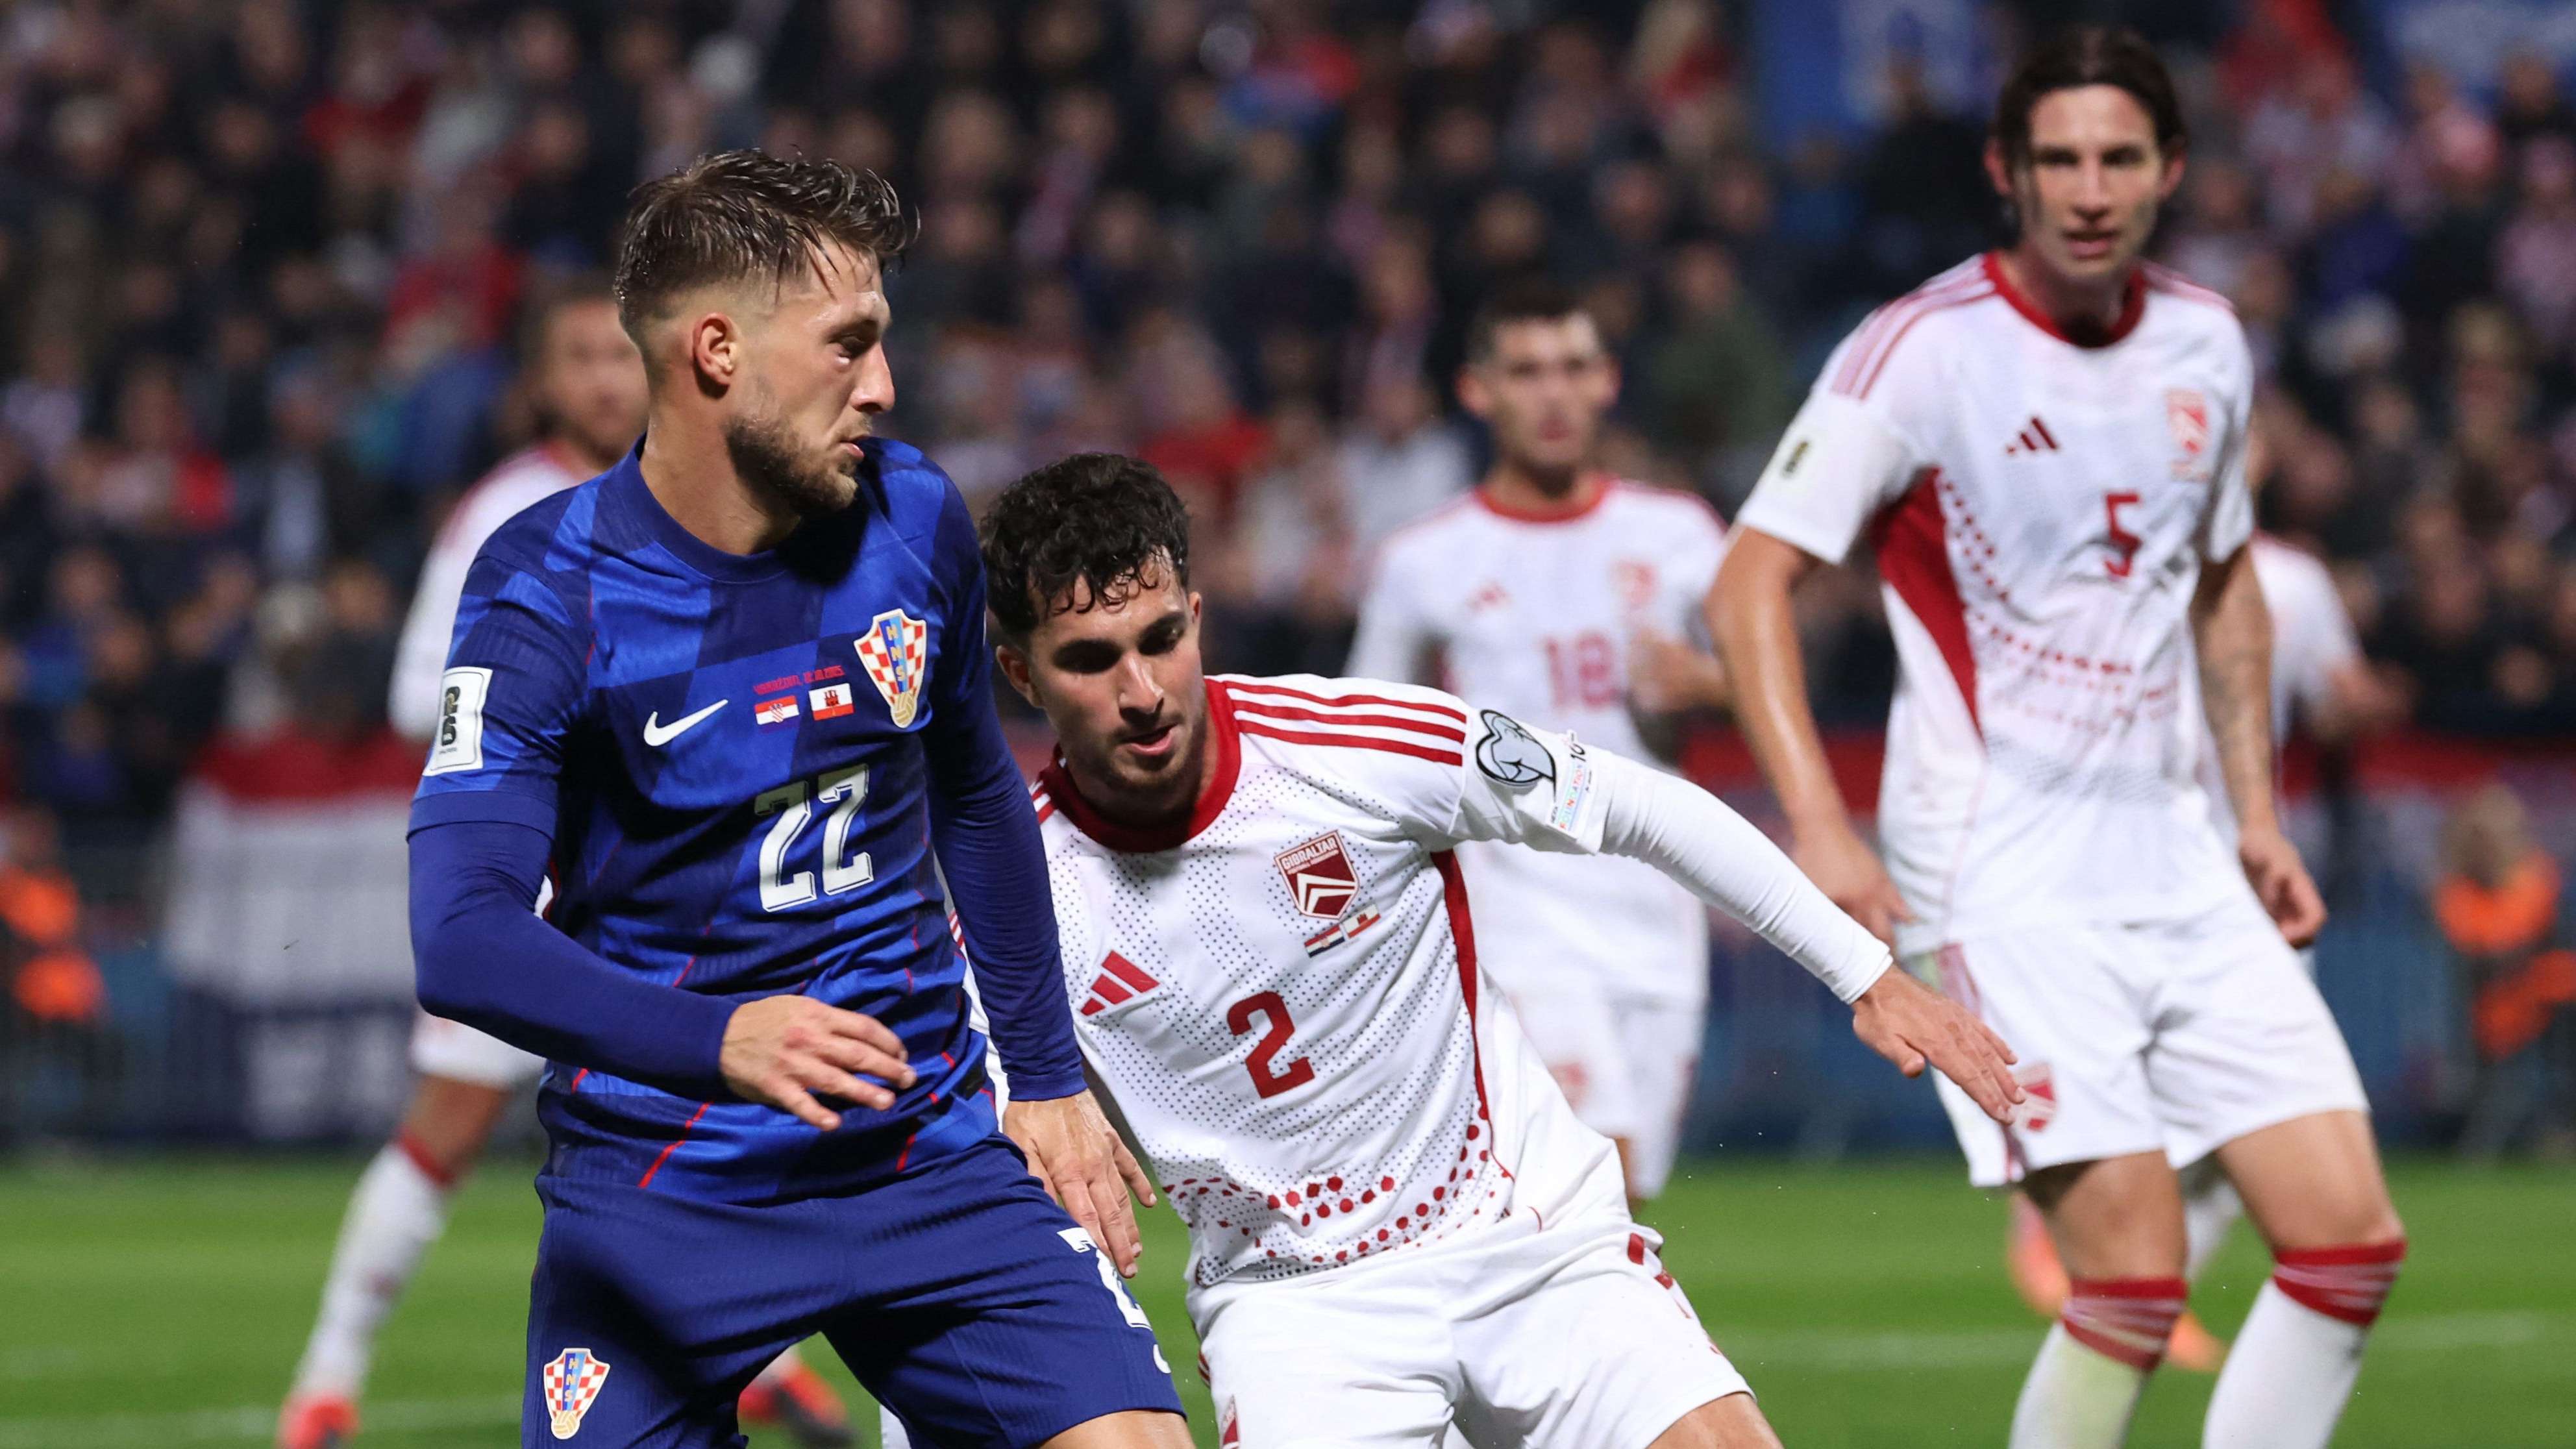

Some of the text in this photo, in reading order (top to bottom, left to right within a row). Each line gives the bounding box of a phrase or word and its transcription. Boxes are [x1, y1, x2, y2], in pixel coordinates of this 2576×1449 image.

[2105, 493, 2144, 576] 5
[753, 763, 874, 913] 22
[1282, 836, 1339, 870] GIBRALTAR
[1226, 990, 1315, 1098] 2
